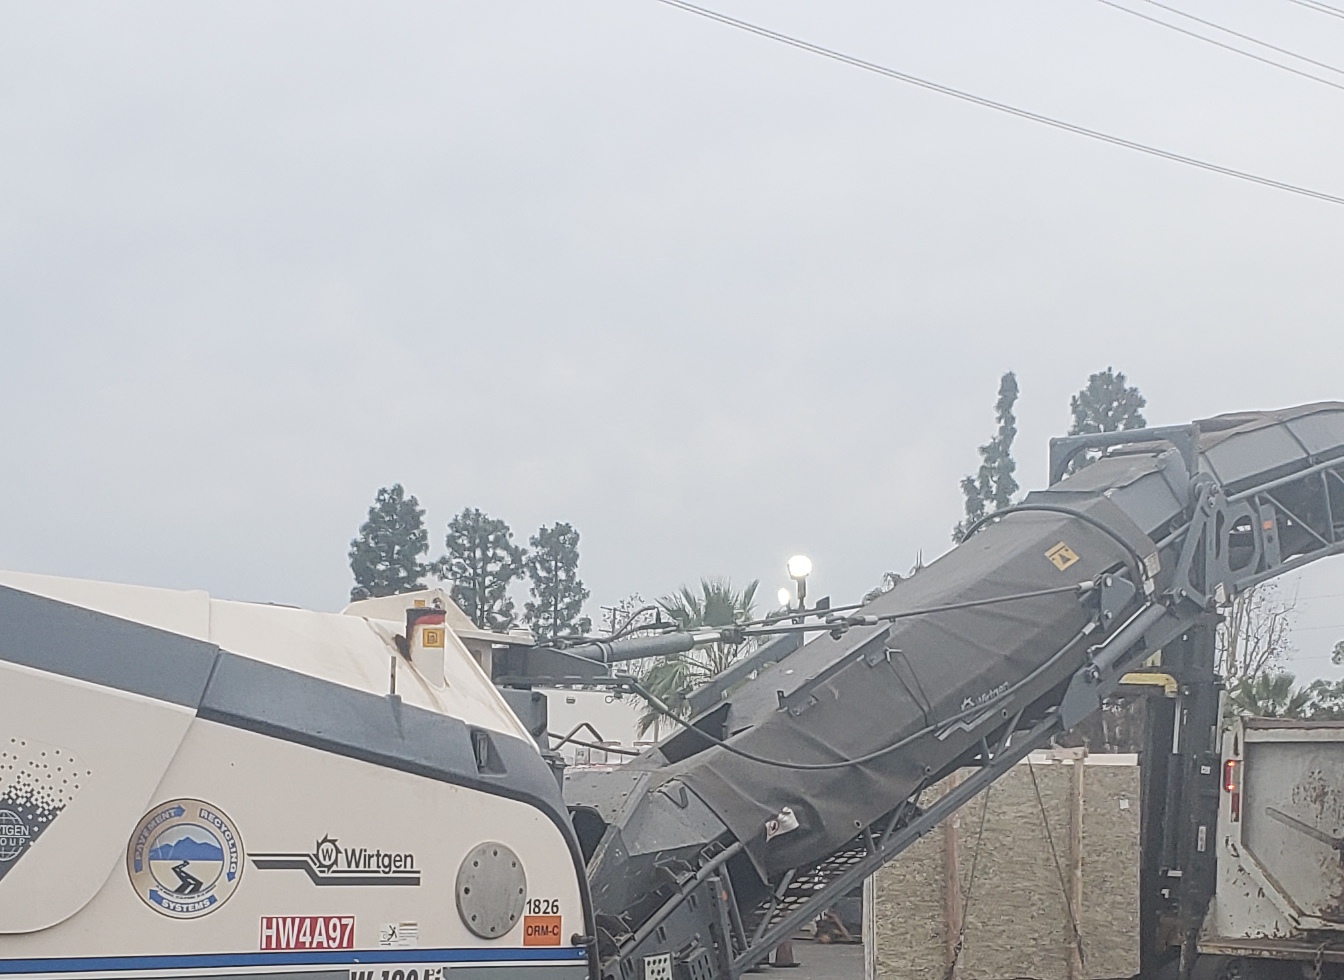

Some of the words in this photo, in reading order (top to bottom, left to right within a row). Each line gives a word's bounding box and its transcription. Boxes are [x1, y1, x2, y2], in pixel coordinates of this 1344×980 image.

[135, 809, 177, 860] PAVEMENT
[200, 809, 238, 873] RECYCLING
[344, 848, 415, 875] Wirtgen
[160, 898, 211, 912] SYSTEMS
[525, 898, 560, 915] 1826
[261, 917, 354, 949] HW4A97
[526, 924, 560, 937] ORM-C
